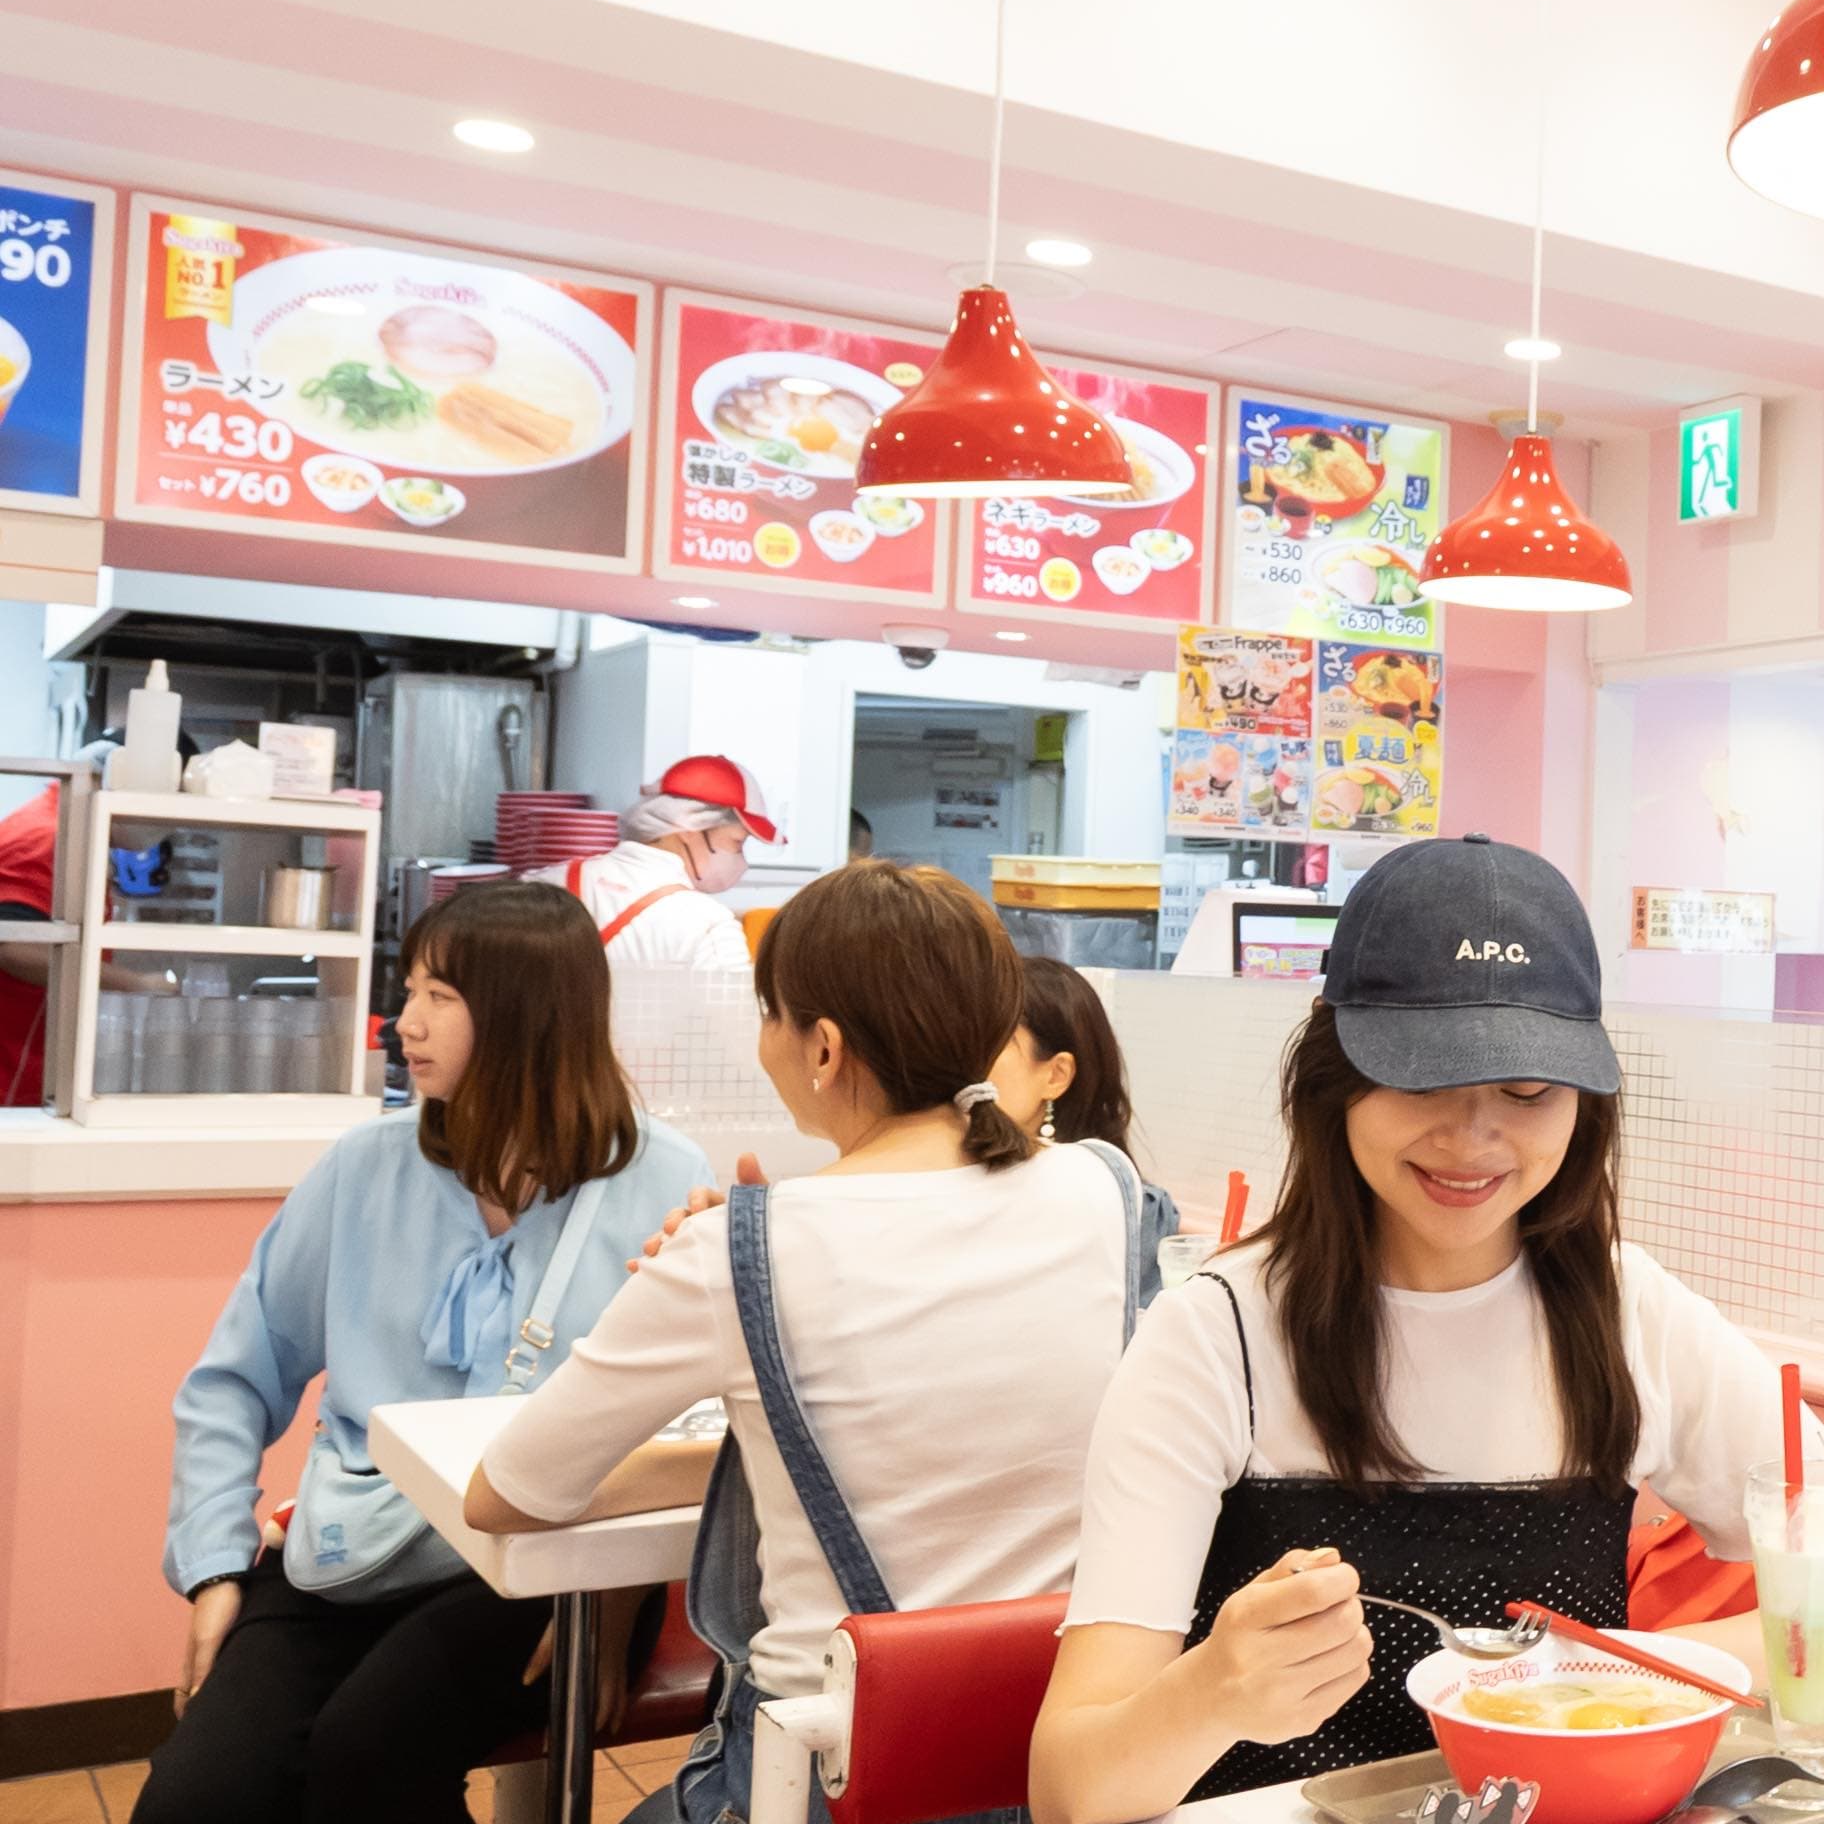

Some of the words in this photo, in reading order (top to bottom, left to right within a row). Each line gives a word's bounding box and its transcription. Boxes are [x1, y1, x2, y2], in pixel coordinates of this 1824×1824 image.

[166, 364, 284, 399] ラーメン
[164, 412, 293, 462] ¥430
[1245, 412, 1292, 466] ざる
[200, 468, 291, 506] ¥760
[987, 501, 1097, 533] ネギラーメン
[1369, 500, 1426, 543] 冷し
[1234, 636, 1282, 653] Frappe
[1323, 645, 1357, 682] ざる
[1455, 938, 1531, 965] A.P.C.
